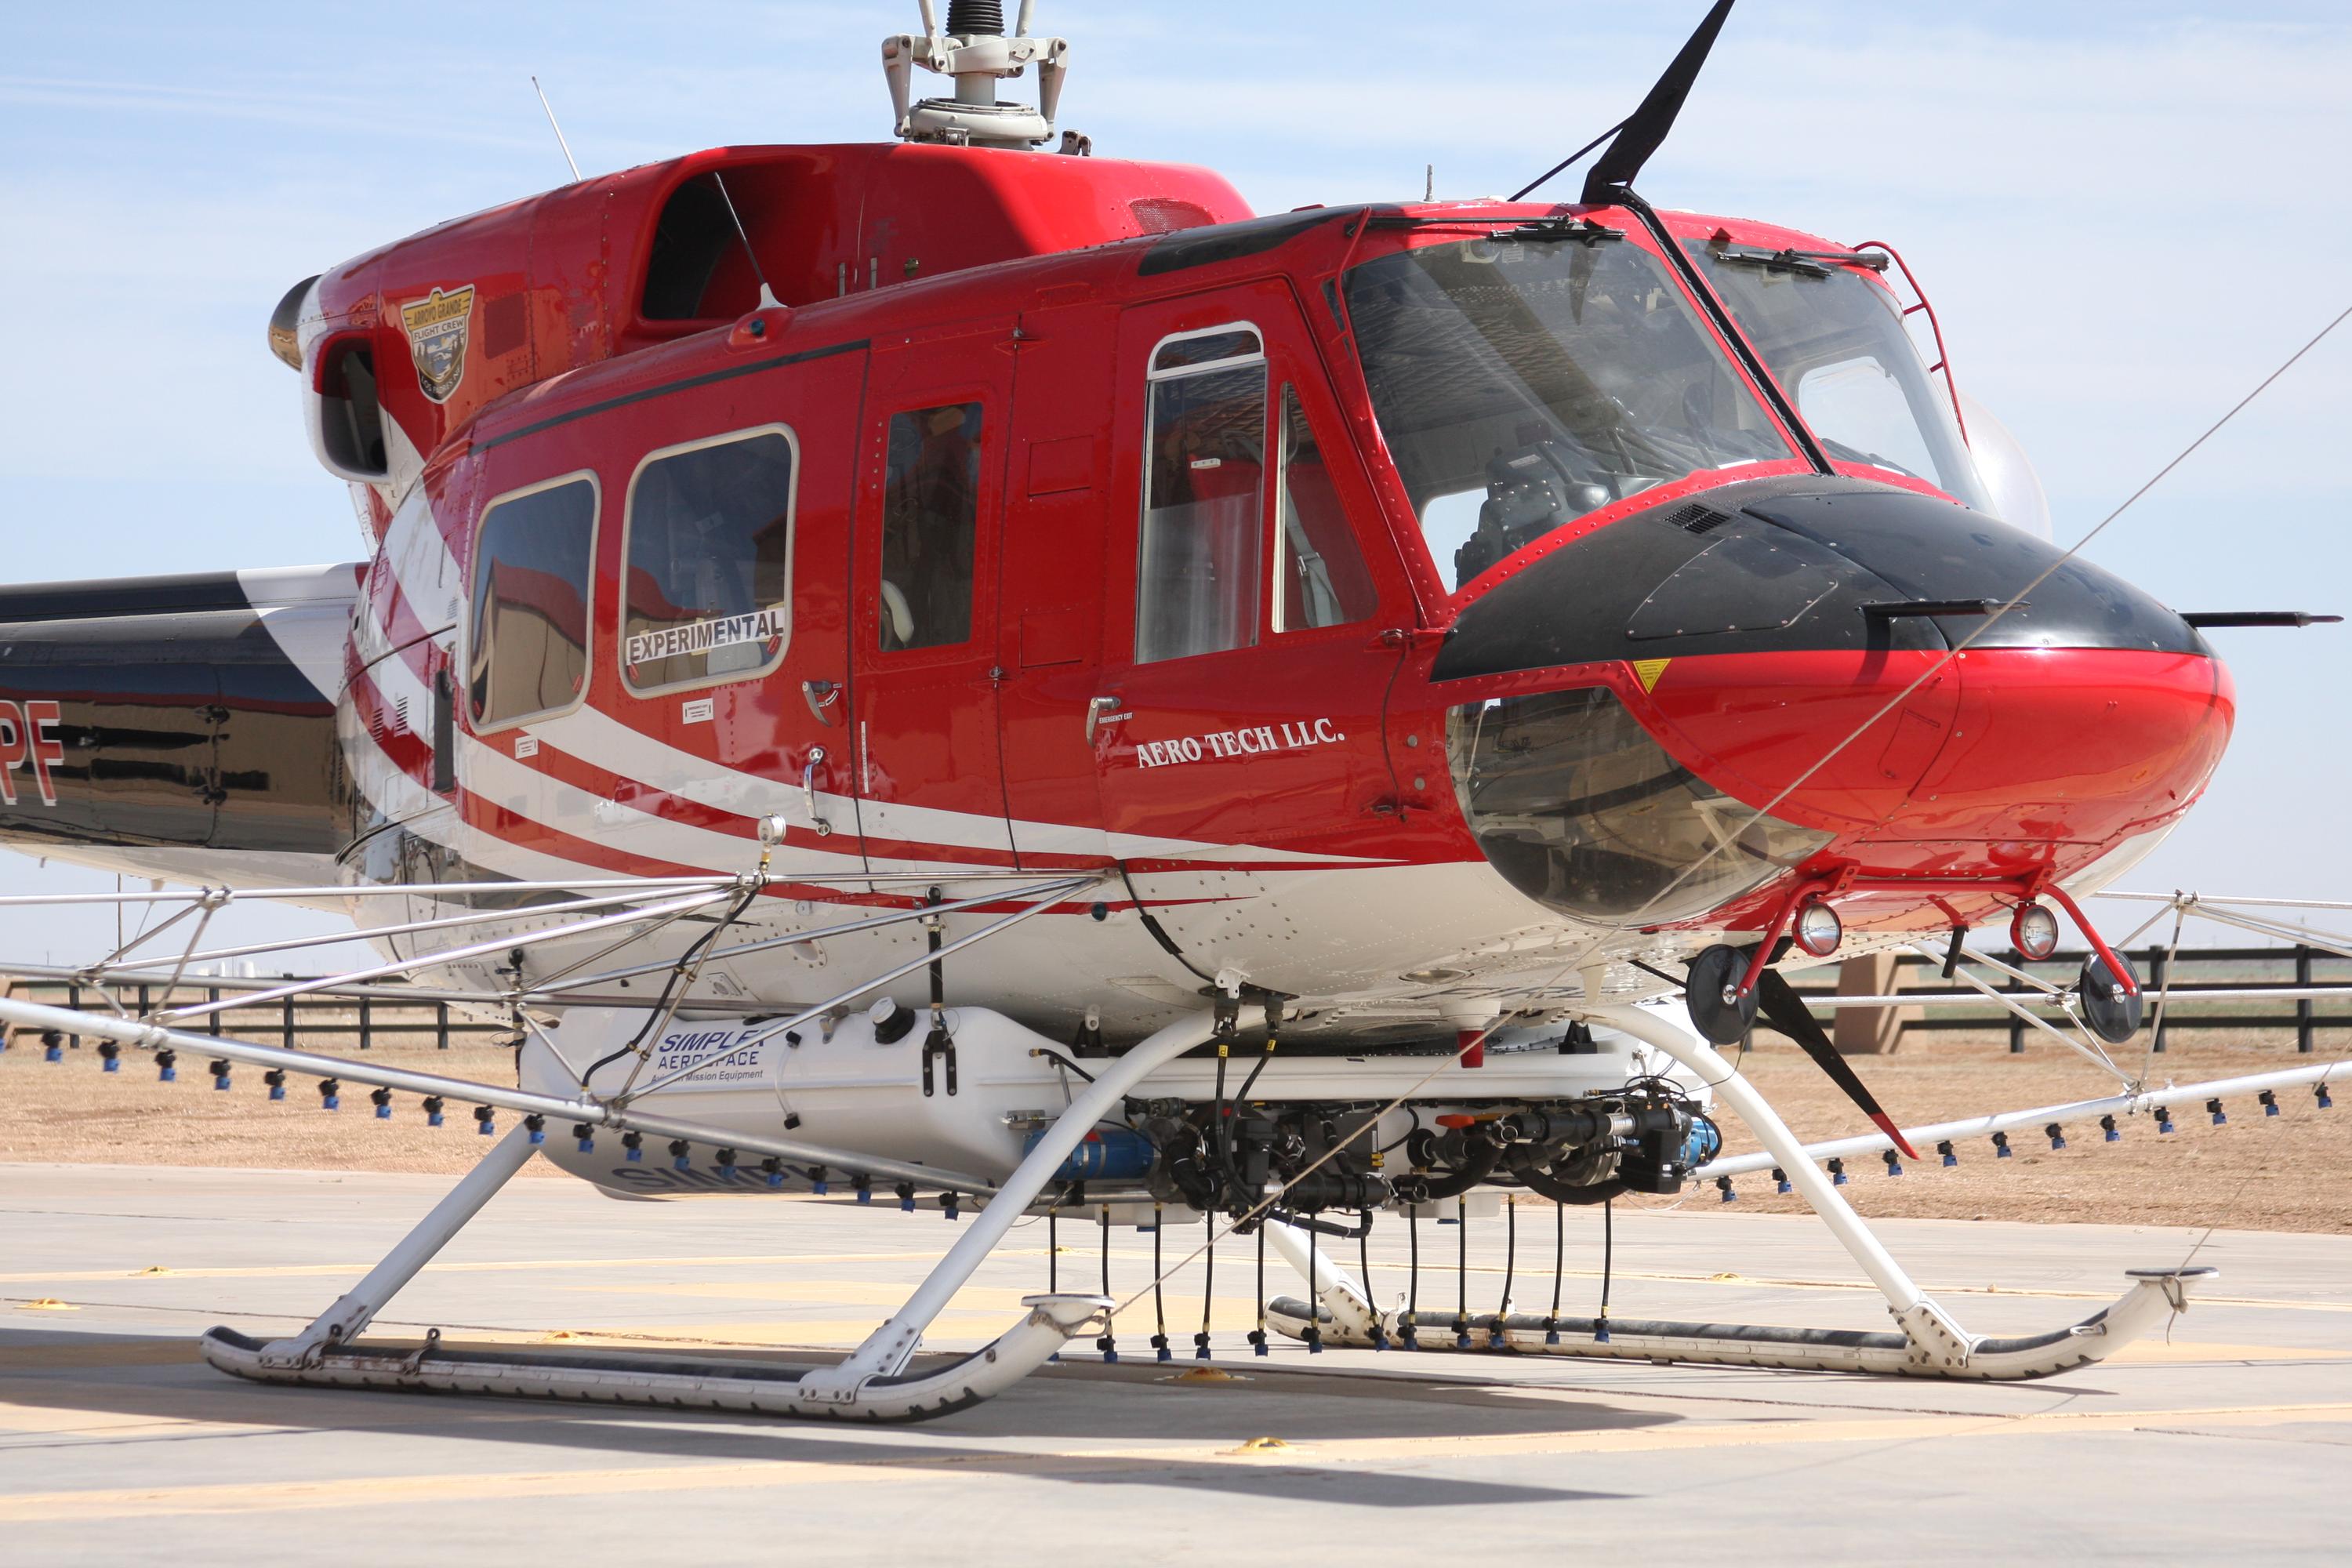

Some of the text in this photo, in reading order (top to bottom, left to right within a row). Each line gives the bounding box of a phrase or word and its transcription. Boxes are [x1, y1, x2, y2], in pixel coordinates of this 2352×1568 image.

[414, 298, 461, 326] ARROYO GRANDE
[414, 318, 464, 339] FLIGHT CREW
[630, 611, 783, 661] EXPERIMENTAL
[1098, 713, 1123, 724] EMERGENCY
[1136, 717, 1345, 769] AERO TECH LLC.
[685, 1072, 717, 1081] Mission
[719, 1070, 764, 1081] Equipment
